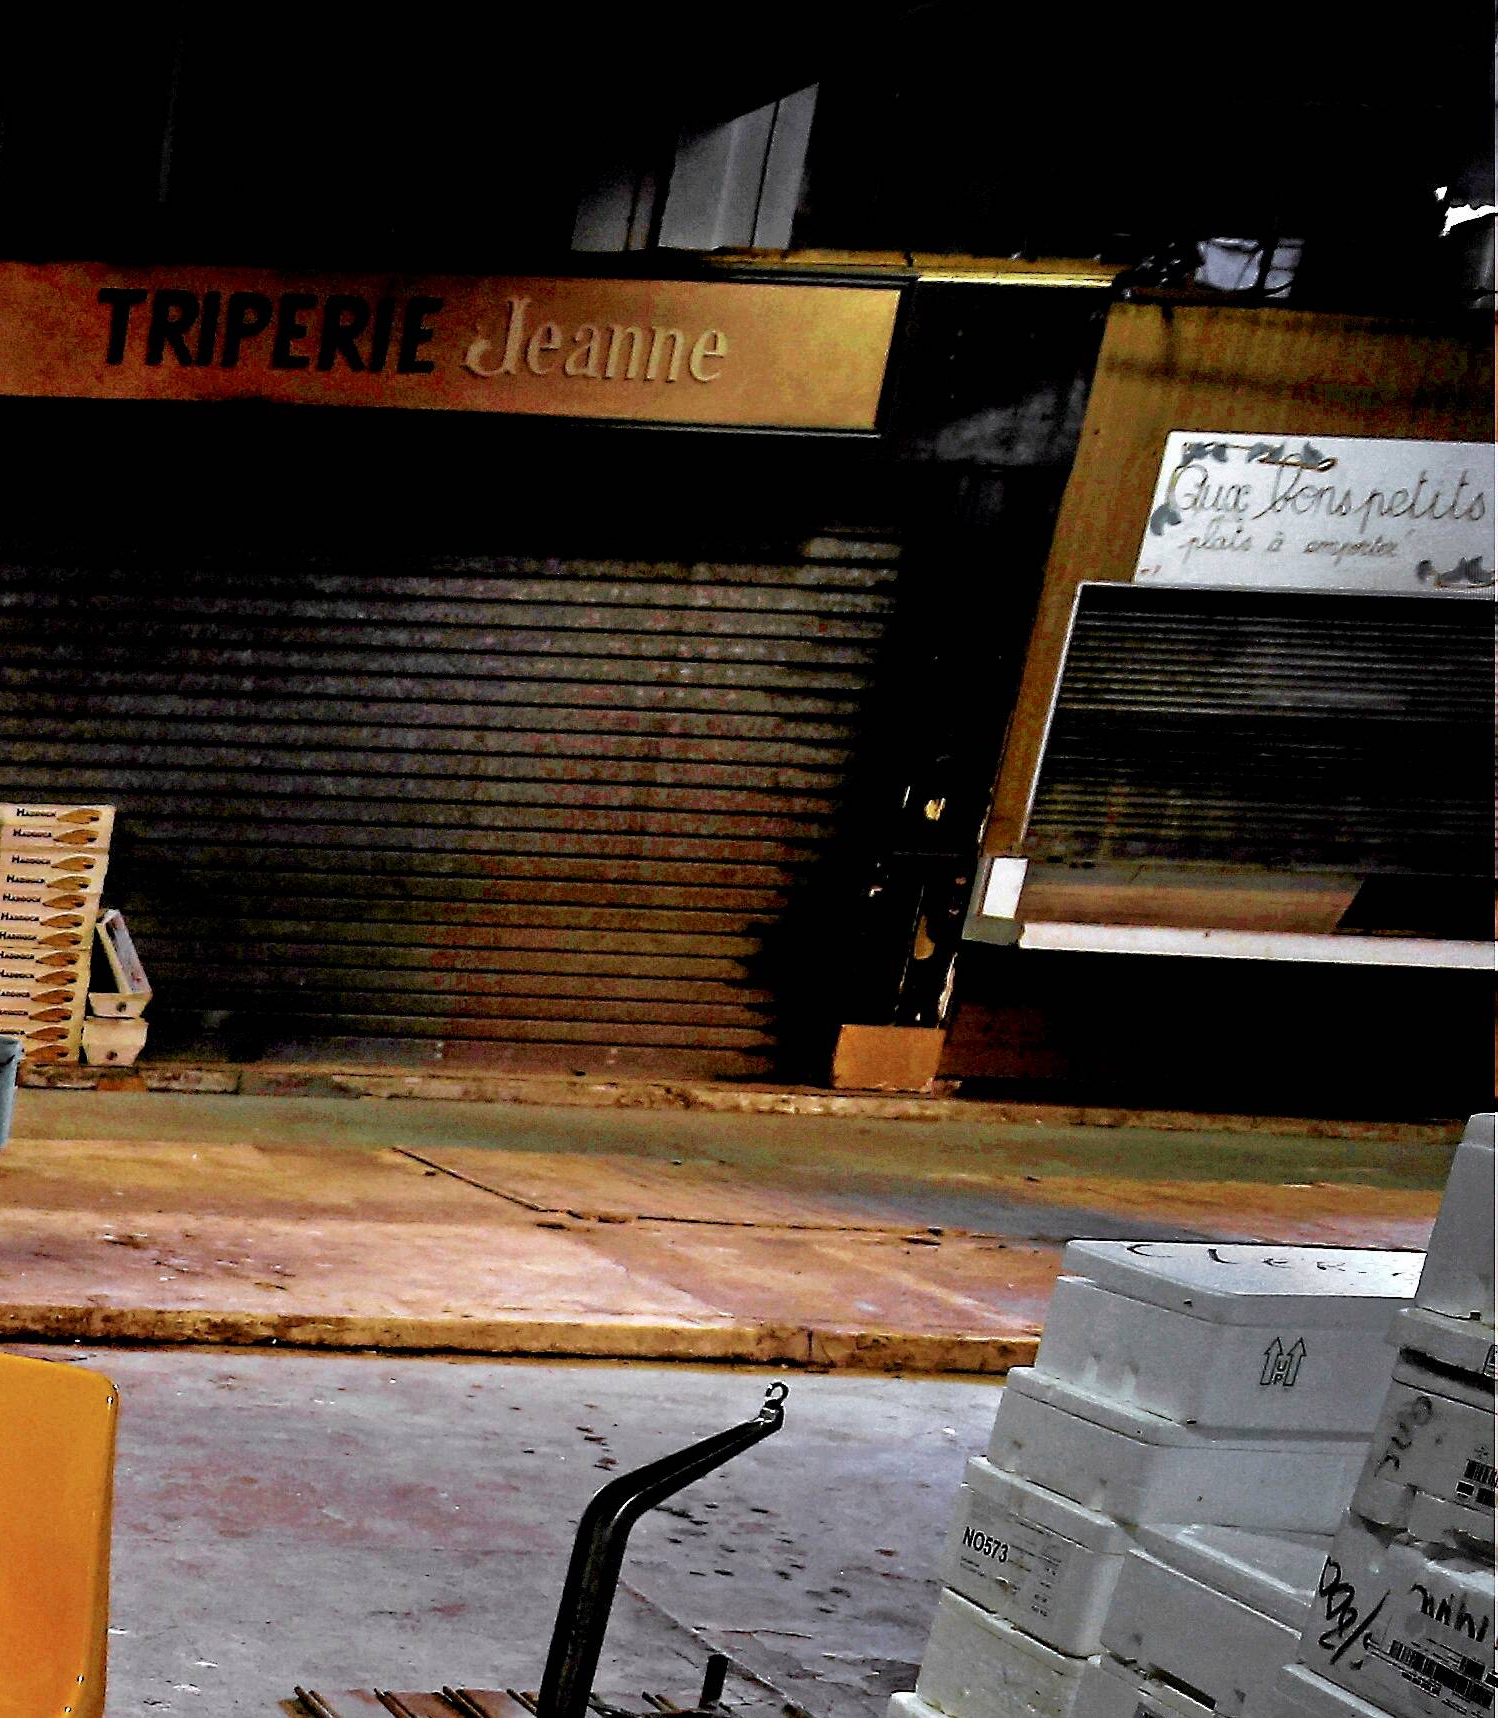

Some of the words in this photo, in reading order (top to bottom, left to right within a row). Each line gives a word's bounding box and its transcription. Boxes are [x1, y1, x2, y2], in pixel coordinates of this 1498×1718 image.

[98, 288, 444, 374] TRIPERIE
[460, 297, 729, 383] Jeanne
[1172, 463, 1252, 513] Aux
[1353, 470, 1487, 534] petits
[962, 1526, 1009, 1563] NO573
